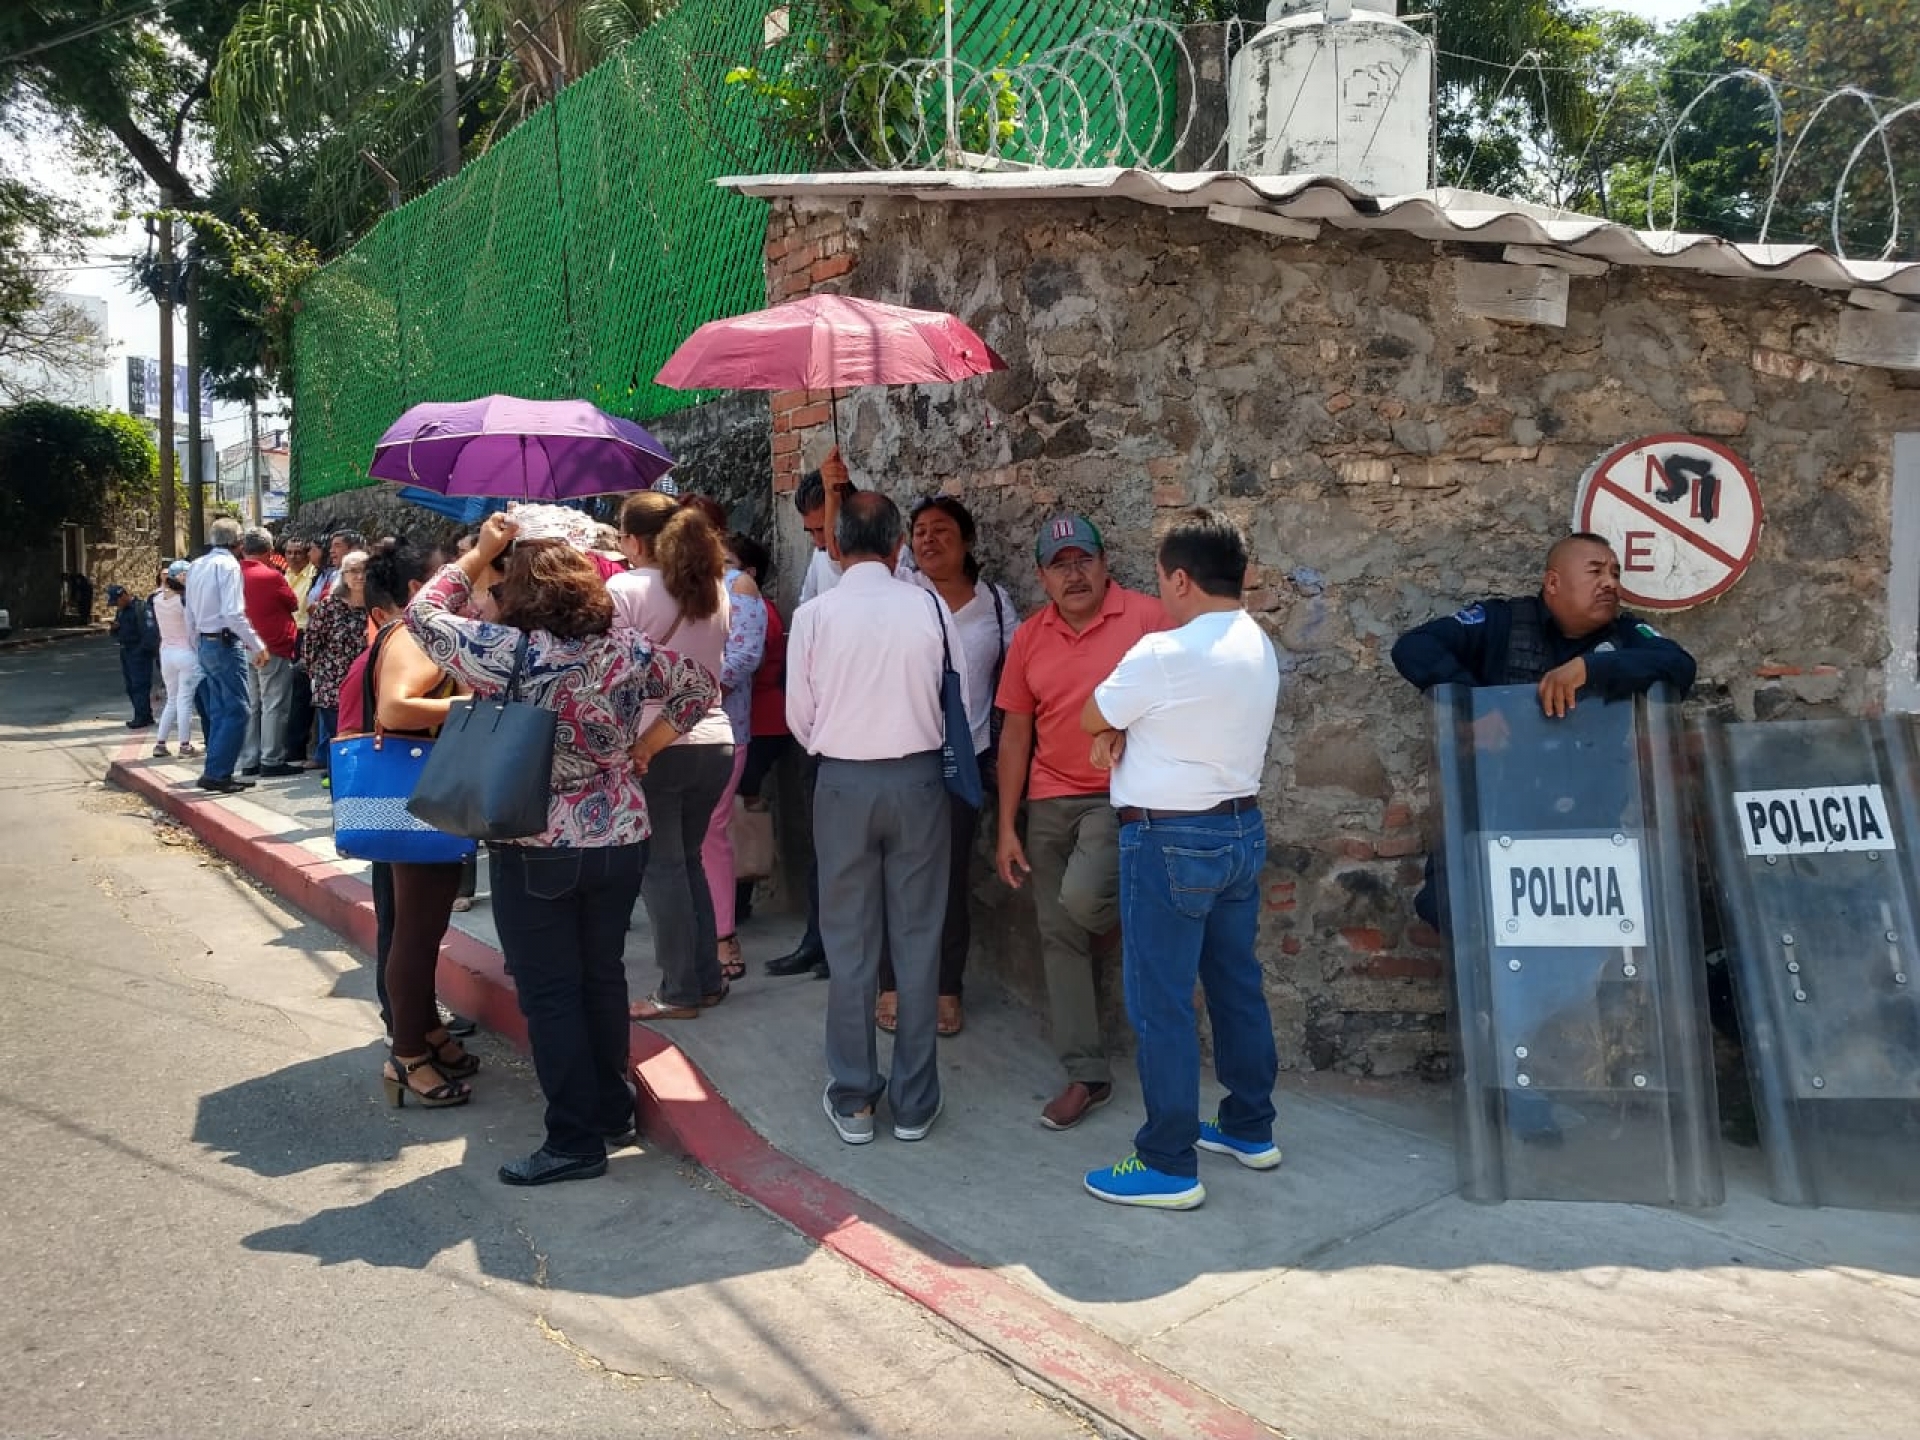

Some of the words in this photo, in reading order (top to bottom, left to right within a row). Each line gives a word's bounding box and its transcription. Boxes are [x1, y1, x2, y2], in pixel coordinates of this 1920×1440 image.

[1624, 531, 1656, 572] E
[1746, 796, 1884, 846] POLICIA
[1510, 866, 1625, 917] POLICIA
